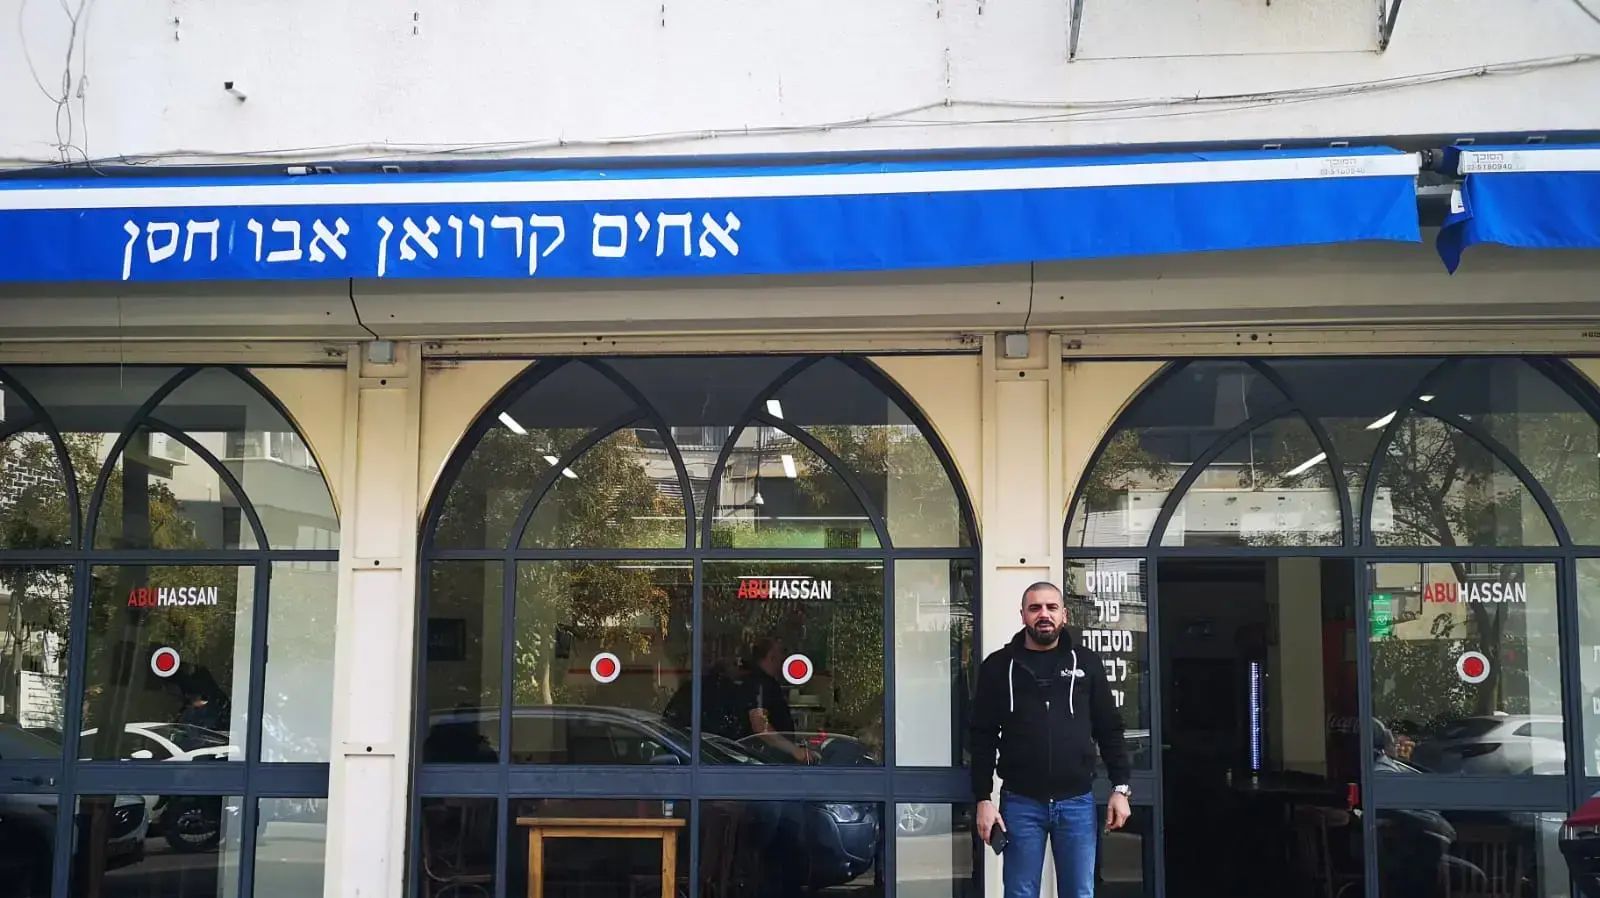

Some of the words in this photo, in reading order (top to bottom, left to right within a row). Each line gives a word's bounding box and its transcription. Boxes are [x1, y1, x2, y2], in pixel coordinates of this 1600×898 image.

[122, 219, 220, 281] חסן
[247, 217, 350, 264] אבו
[377, 213, 565, 277] קרוואן
[592, 211, 741, 258] אחים
[1085, 570, 1128, 593] חומוס
[1094, 597, 1120, 623] פול
[1082, 629, 1133, 653] מסבחה
